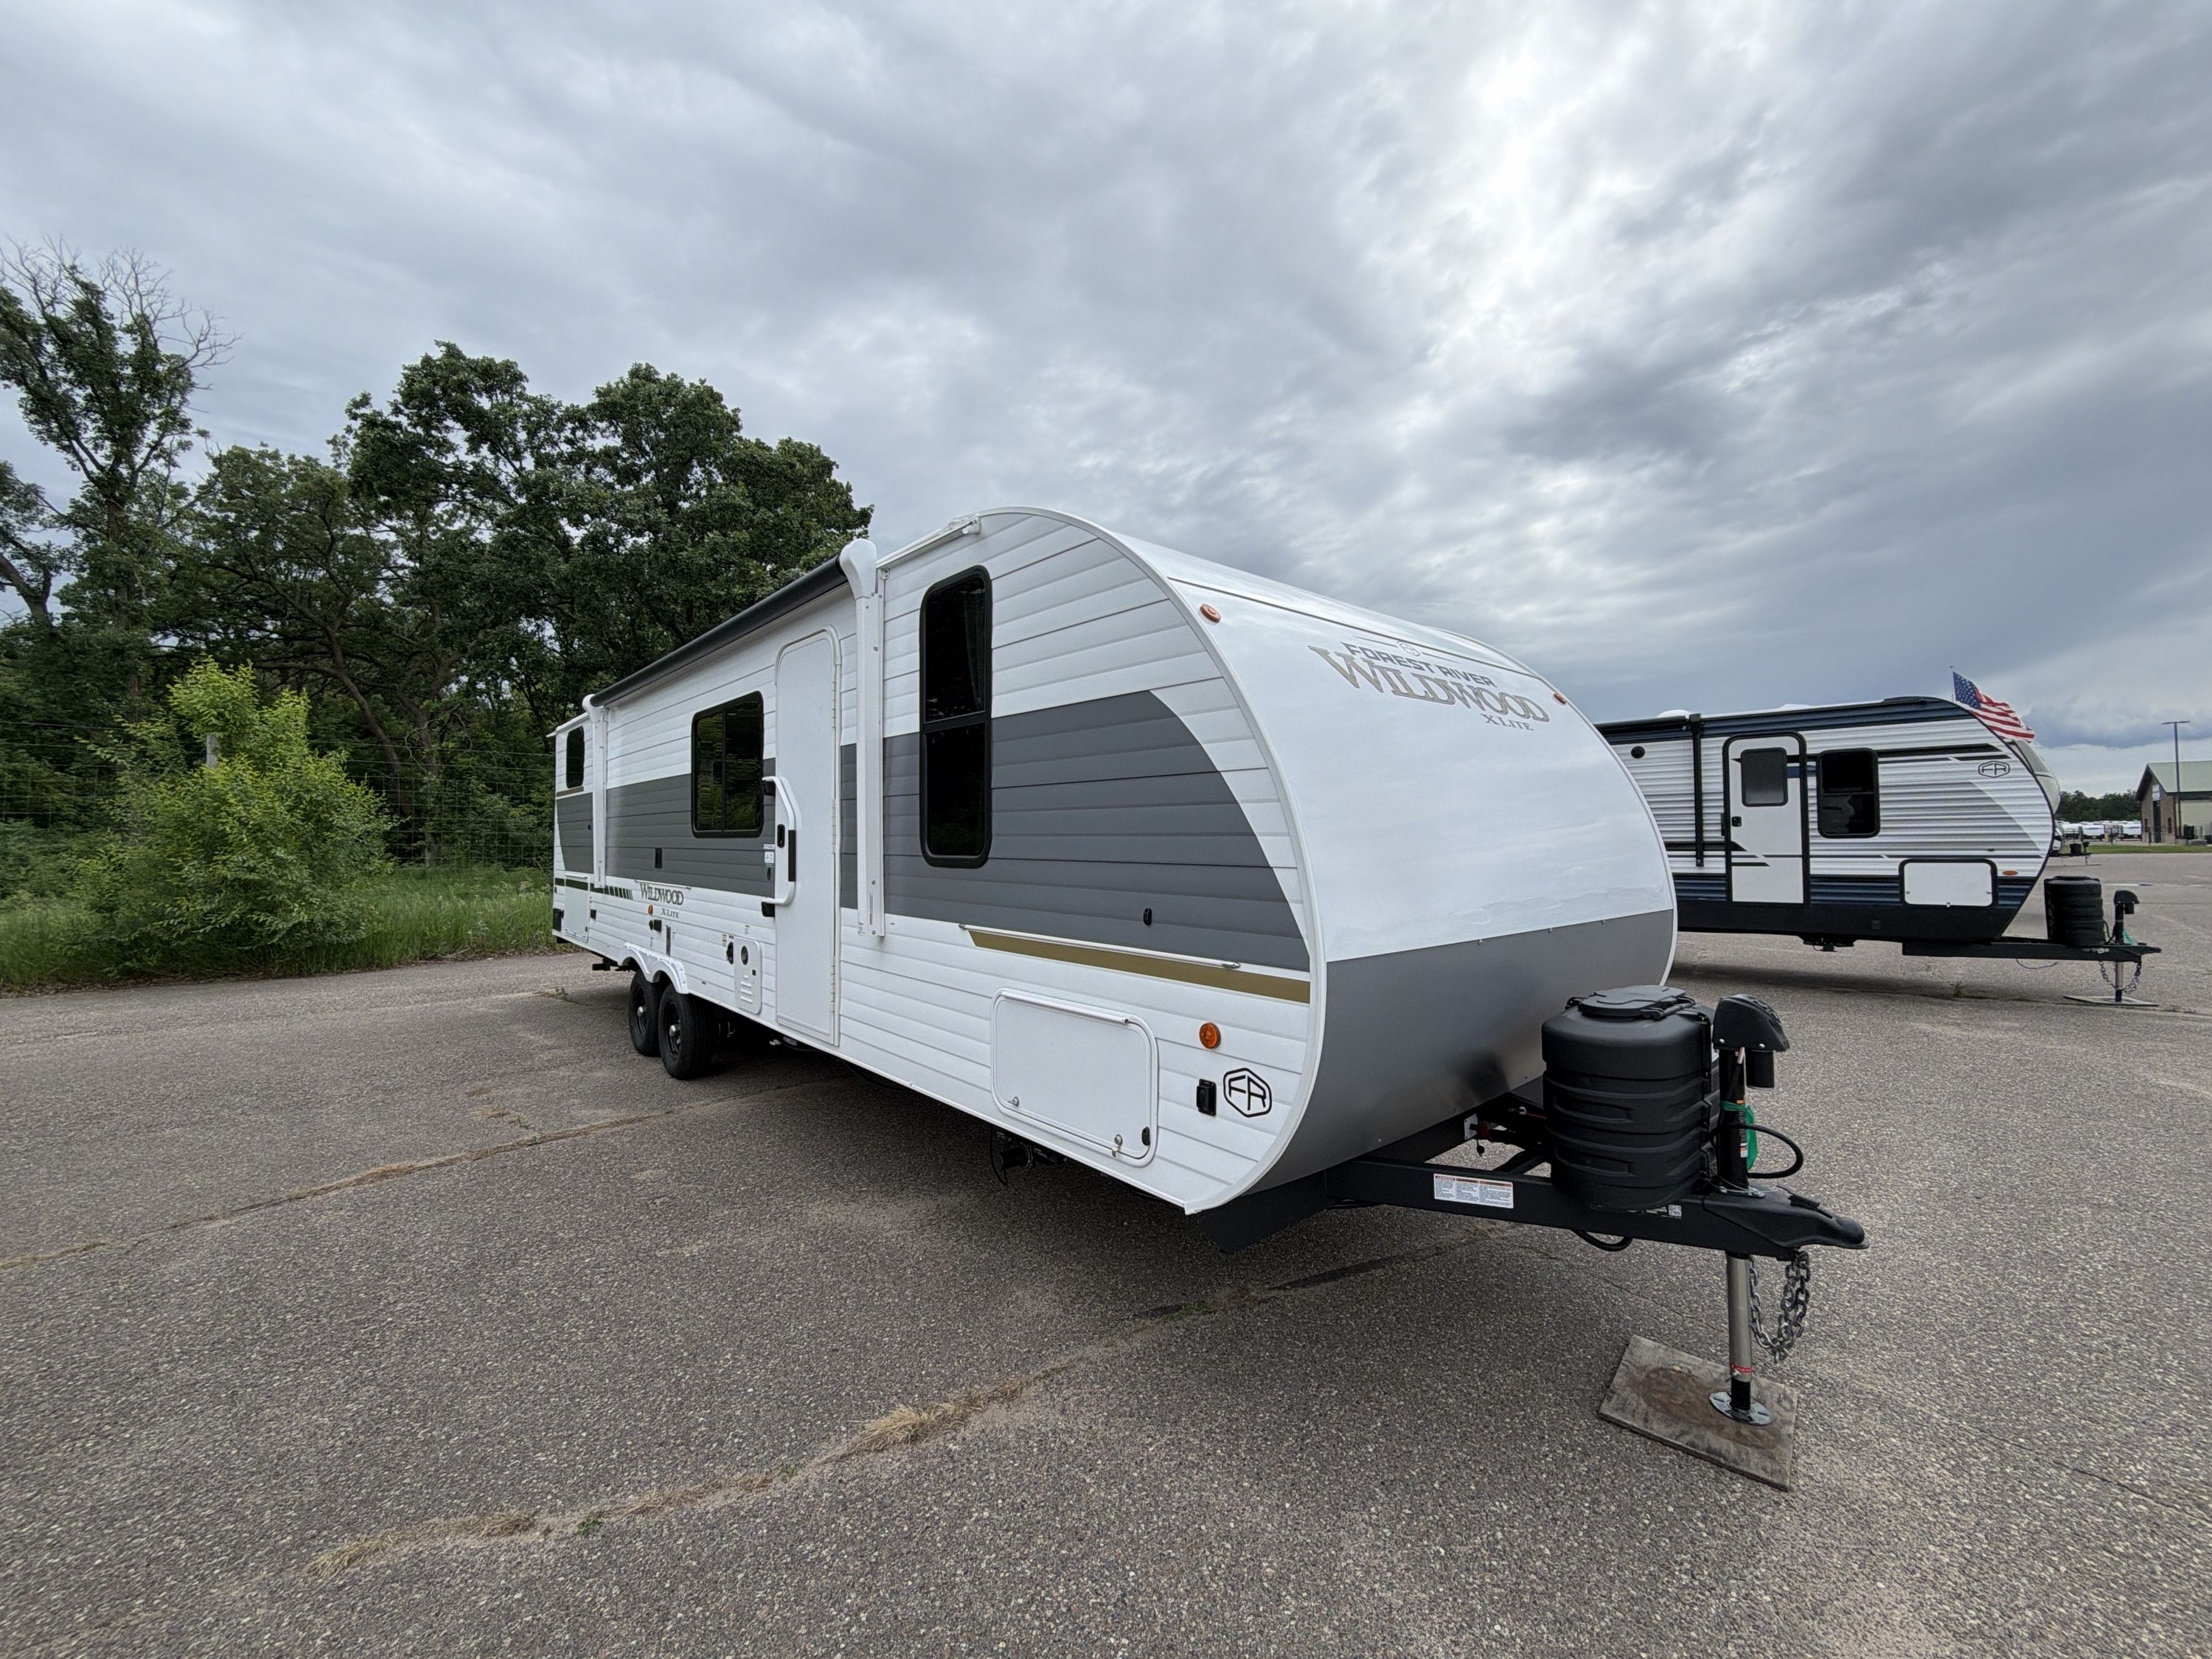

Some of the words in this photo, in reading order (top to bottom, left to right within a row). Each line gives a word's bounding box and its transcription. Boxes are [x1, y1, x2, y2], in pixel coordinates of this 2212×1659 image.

[1308, 645, 1549, 722] WILDWOOD
[1340, 642, 1435, 673] FOREST
[1435, 664, 1498, 688] RIVER
[640, 883, 684, 905] WILDWOOD
